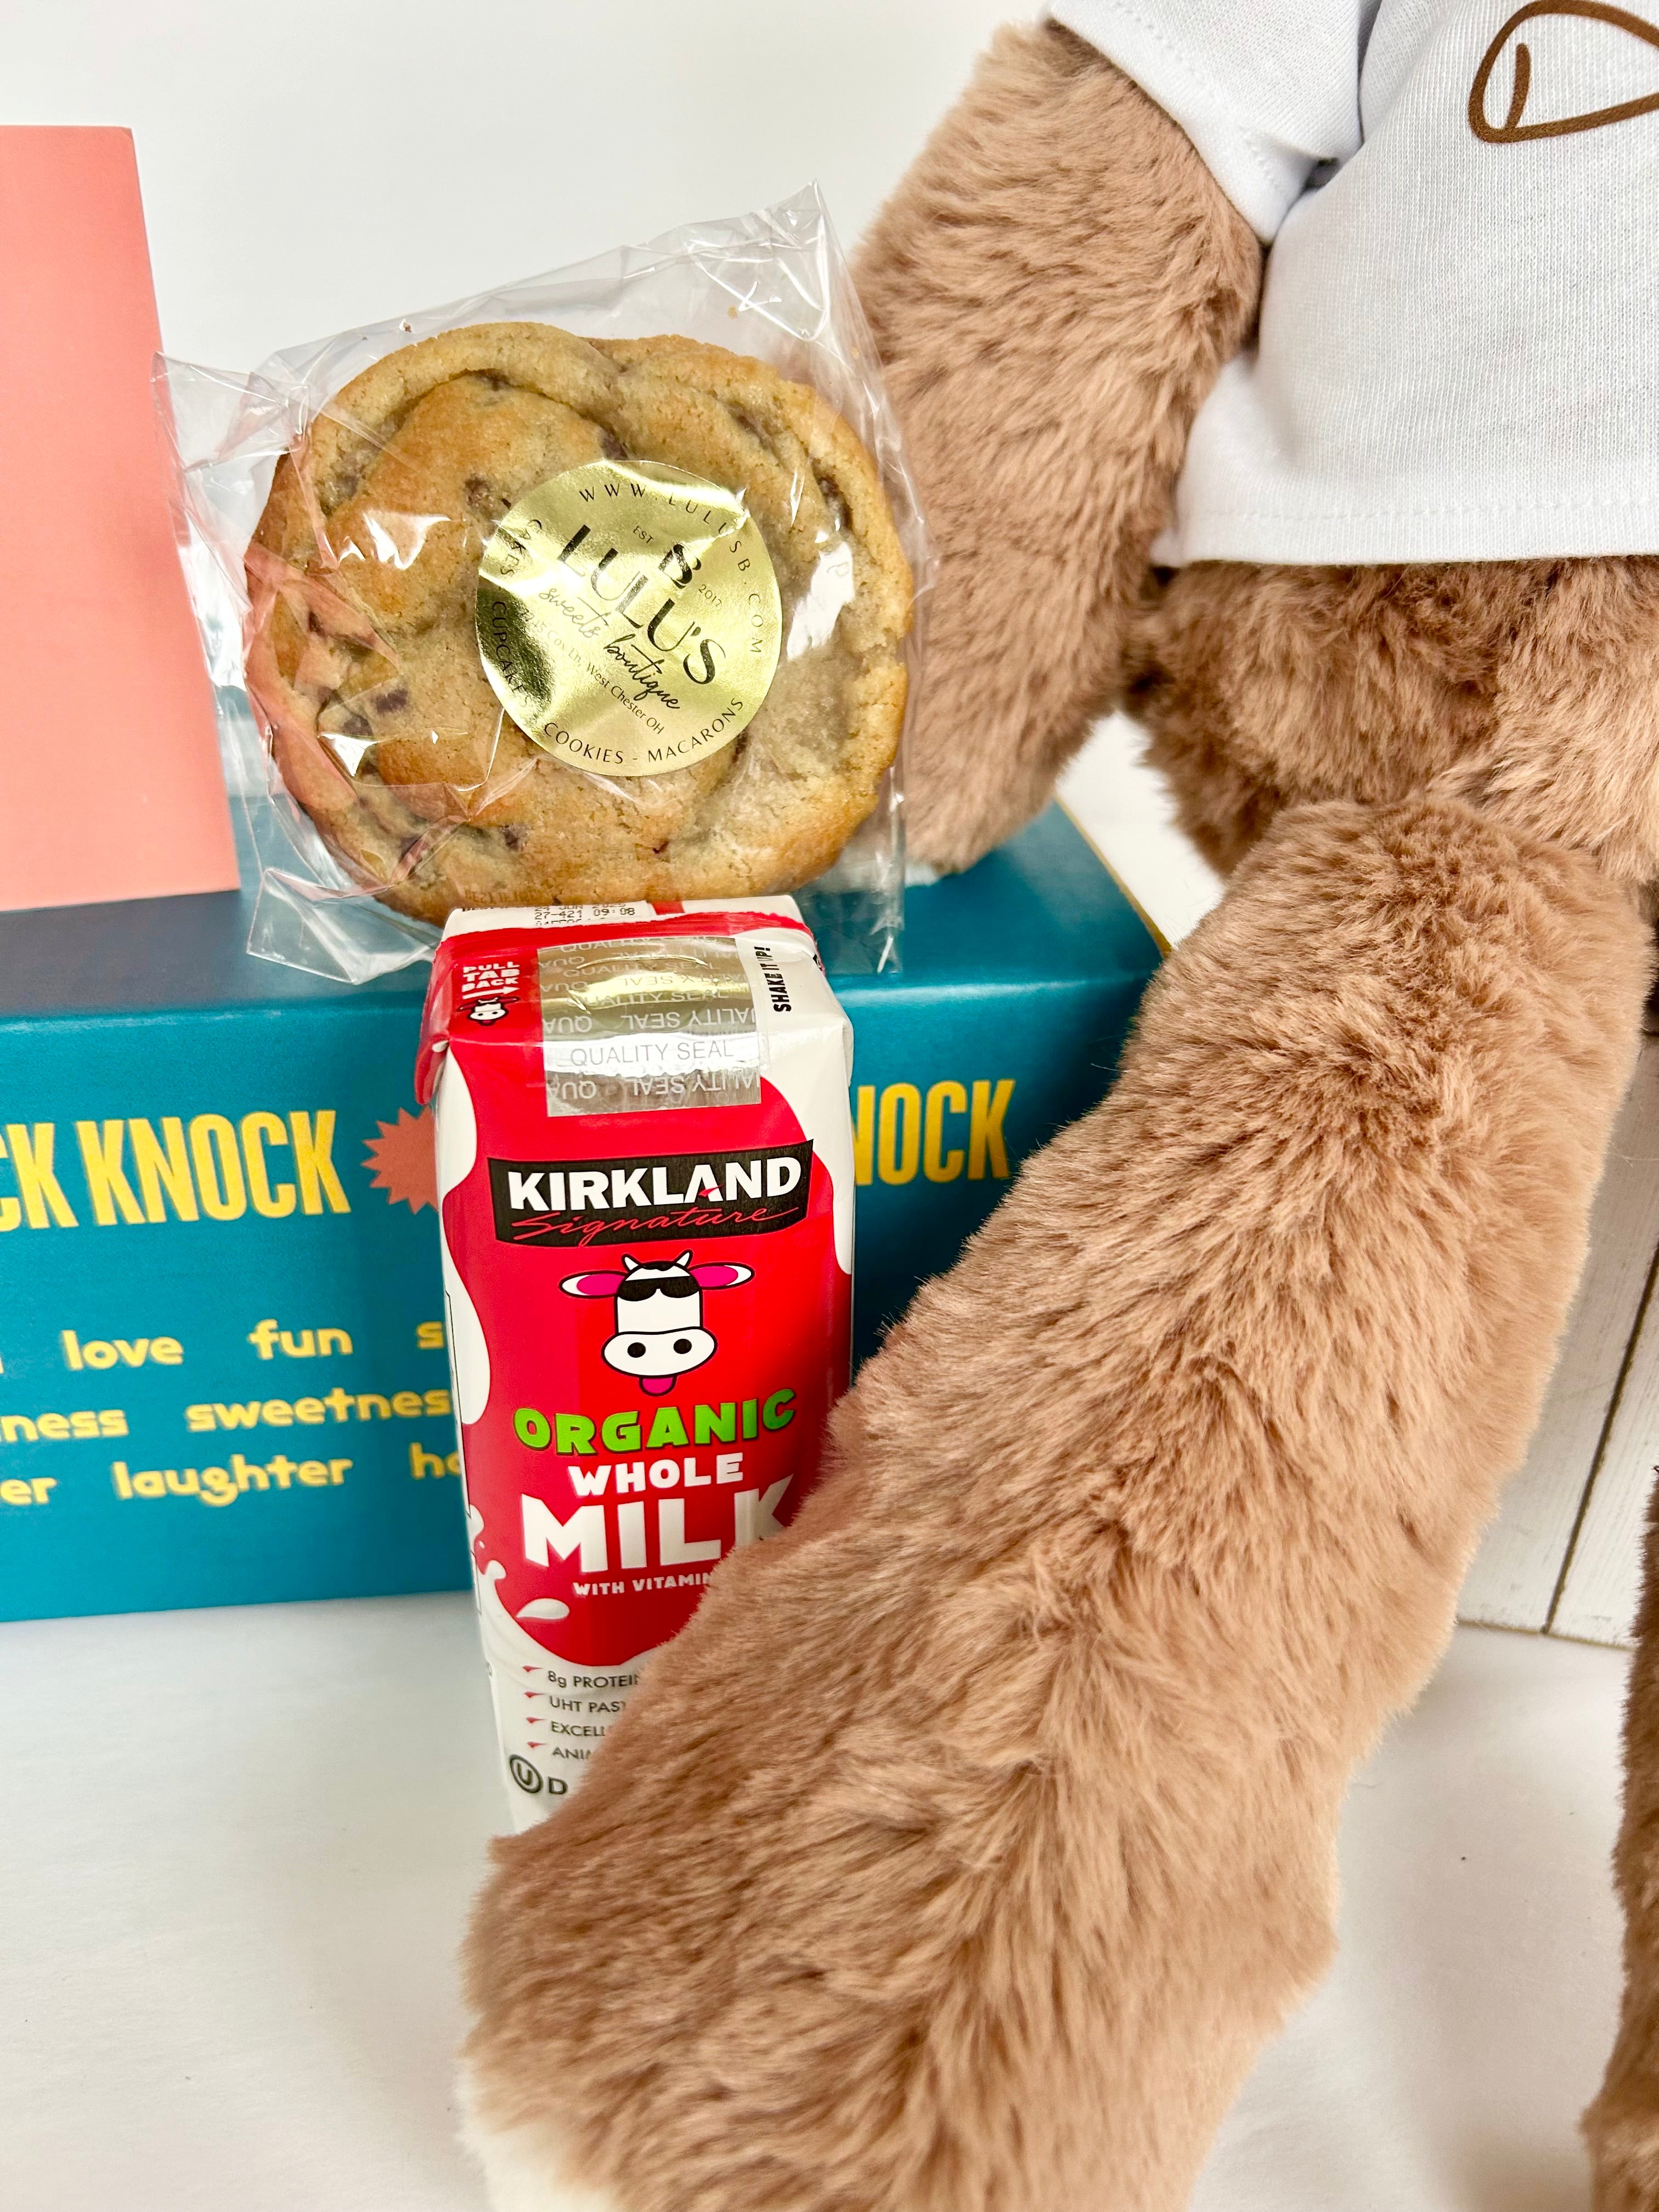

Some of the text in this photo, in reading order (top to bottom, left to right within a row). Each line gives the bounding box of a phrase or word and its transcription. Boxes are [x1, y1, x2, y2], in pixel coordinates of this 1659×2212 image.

[633, 526, 654, 544] EST
[698, 584, 723, 607] 2017
[558, 524, 726, 684] LULU'S
[539, 588, 680, 709] sweets boutique
[586, 662, 610, 689] West
[611, 686, 646, 719] Chester
[646, 717, 664, 735] OH
[544, 722, 623, 764] COOKIES
[648, 698, 743, 763] MACARONS
[535, 910, 582, 920] 27-421
[463, 961, 520, 973] PULL
[754, 946, 774, 961] UP!
[461, 977, 518, 992] BACK
[462, 969, 520, 982] TAB
[764, 973, 792, 1012] SHAKE
[621, 1012, 680, 1030] SEAL
[571, 1040, 734, 1066] QUALITY SEAL
[624, 1076, 685, 1096] SEAL
[75, 1110, 352, 1227] KNOCK
[507, 1156, 802, 1211] KIRKLAND
[511, 1206, 799, 1247] Signature
[61, 1329, 184, 1372] love
[248, 1319, 353, 1361] fun
[513, 1388, 795, 1455] ORGANIC
[111, 1454, 353, 1508] laughter
[568, 1452, 743, 1497] WHOLE
[521, 1475, 793, 1573] MILK
[573, 1581, 625, 1596] WITH
[548, 1671, 567, 1688] 8g
[549, 1695, 582, 1712] UHT
